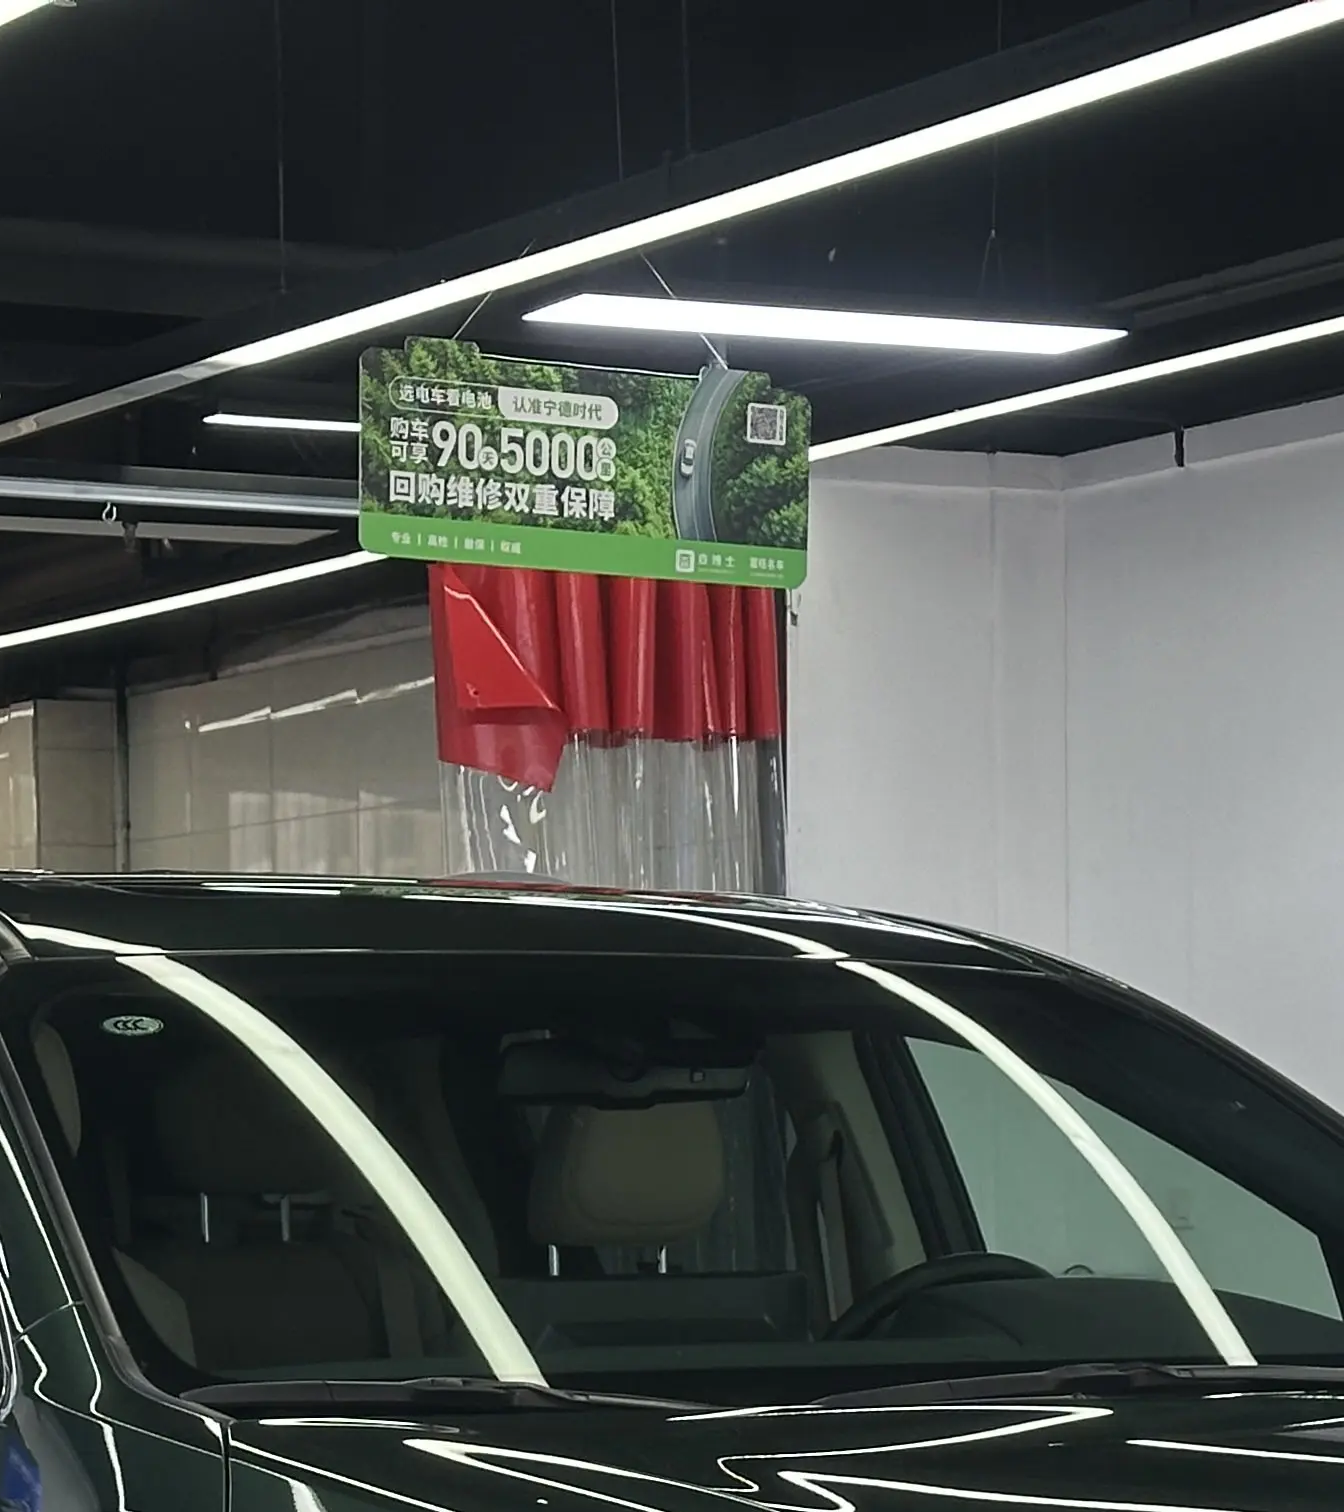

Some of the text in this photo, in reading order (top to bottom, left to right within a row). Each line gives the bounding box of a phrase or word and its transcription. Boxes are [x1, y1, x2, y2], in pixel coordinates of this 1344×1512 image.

[512, 396, 602, 421] 认准宁德时代
[390, 417, 429, 440] 购车
[390, 440, 429, 464] 可享
[390, 470, 615, 520] 回购维修双重保障
